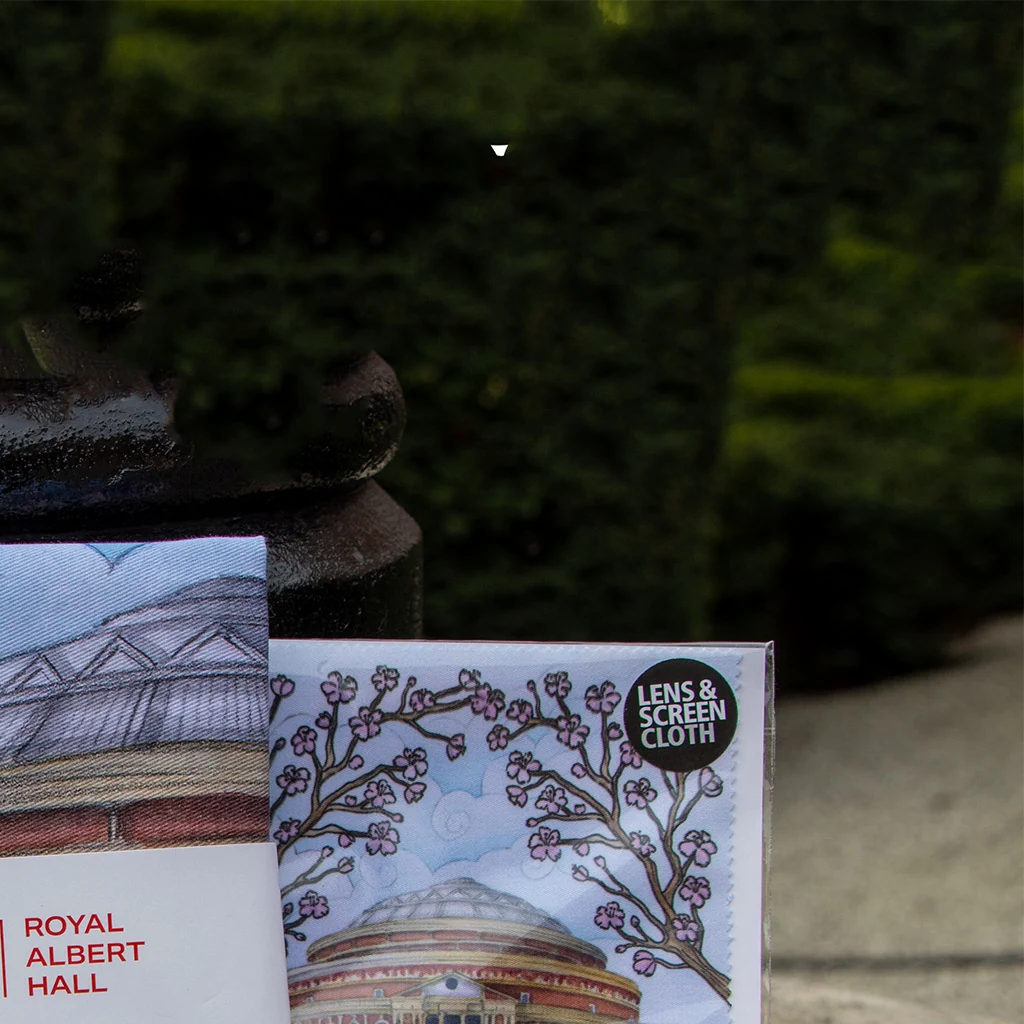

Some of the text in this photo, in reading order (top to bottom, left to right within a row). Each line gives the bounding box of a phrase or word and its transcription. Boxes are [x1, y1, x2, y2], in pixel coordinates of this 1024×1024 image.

[638, 679, 717, 706] LENS &
[639, 700, 726, 728] SCREEN
[641, 722, 715, 749] CLOTH
[25, 913, 124, 937] ROYAL
[26, 941, 145, 967] ALBERT
[28, 973, 108, 996] HALL
